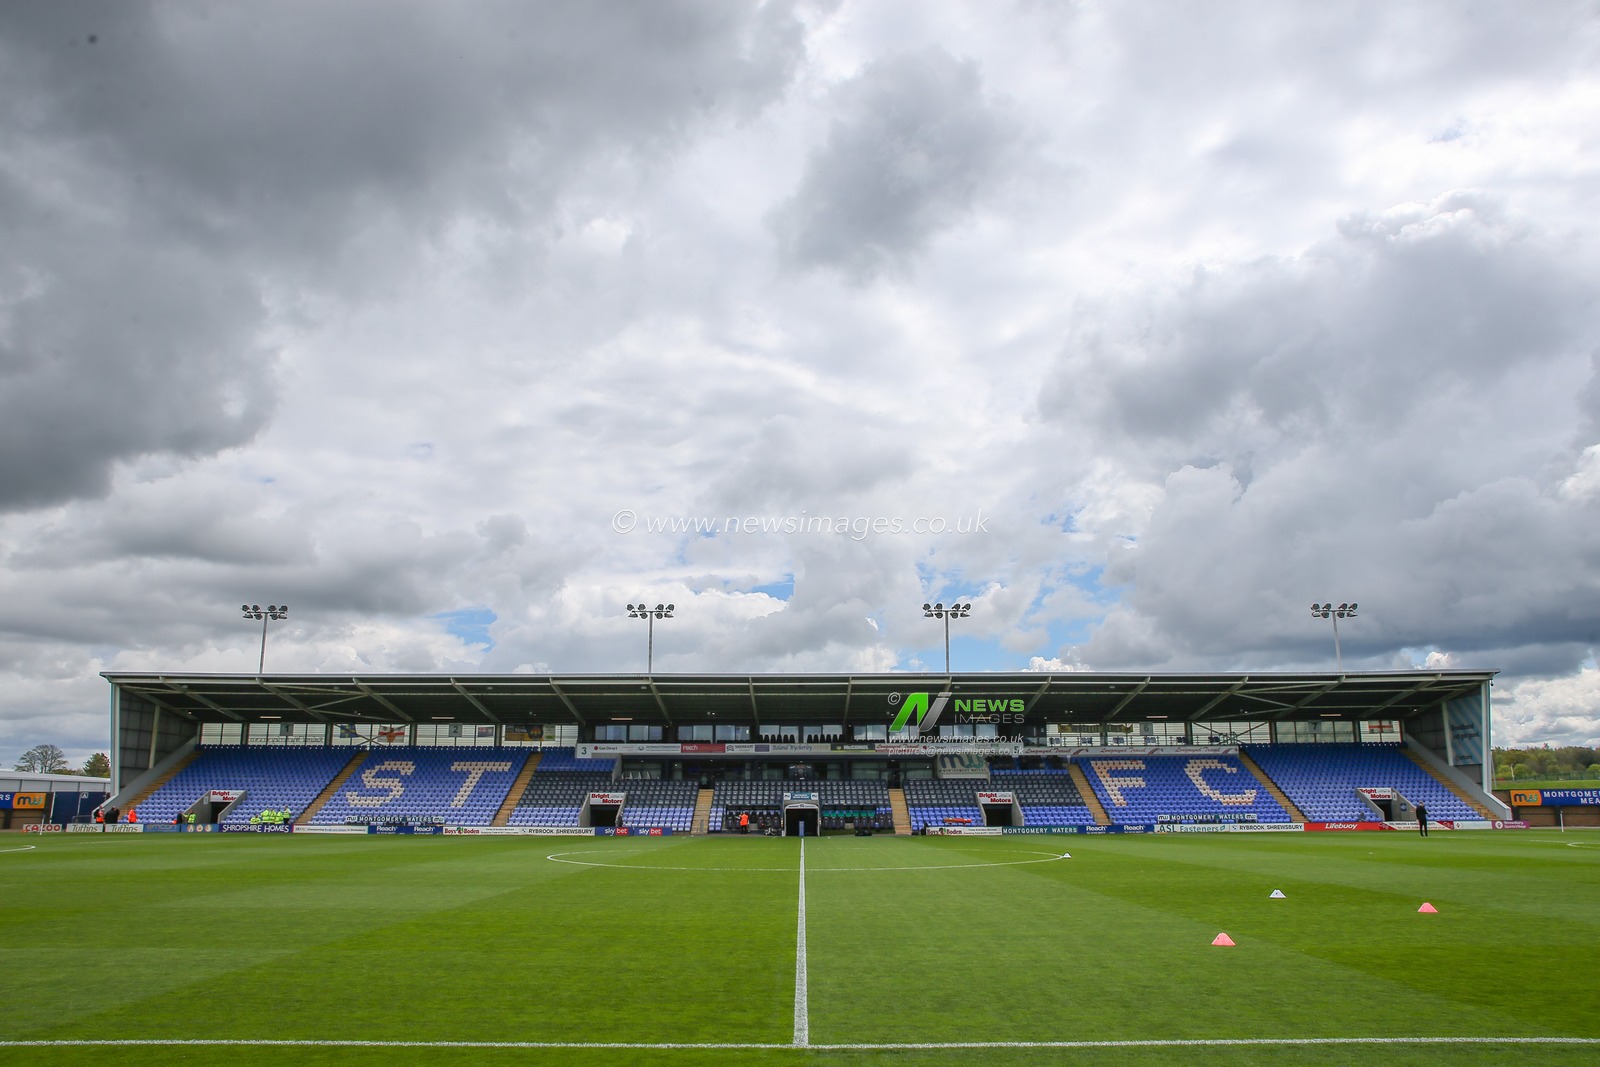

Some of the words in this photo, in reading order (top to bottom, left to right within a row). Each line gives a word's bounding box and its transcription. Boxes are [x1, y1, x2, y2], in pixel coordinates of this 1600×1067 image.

[452, 725, 459, 734] 2
[581, 746, 587, 755] 3
[451, 762, 513, 807] T
[26, 824, 61, 832] CAZOO
[222, 824, 262, 833] SHROPSHIRE
[263, 825, 290, 833] HOMES
[639, 828, 650, 836] sky
